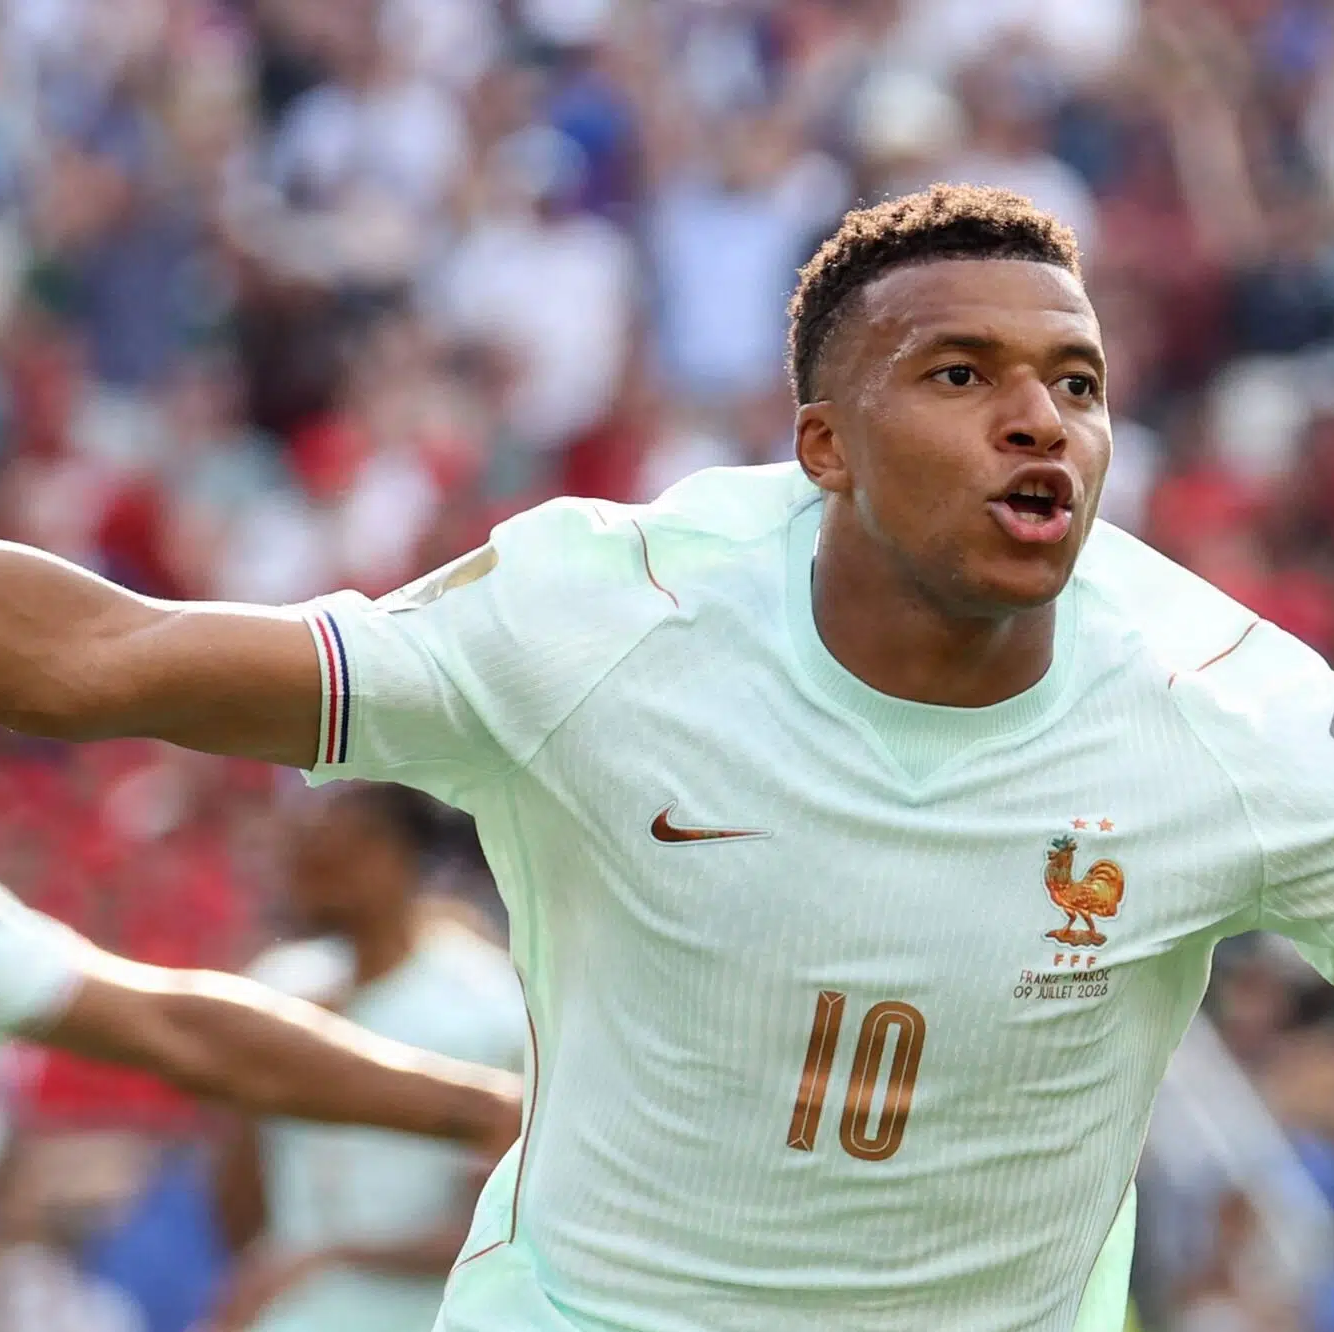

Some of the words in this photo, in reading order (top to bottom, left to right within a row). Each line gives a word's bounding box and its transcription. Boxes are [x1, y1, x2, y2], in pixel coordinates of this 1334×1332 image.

[1019, 969, 1060, 985] FRANCE
[1071, 968, 1112, 984] MAROC
[1013, 985, 1033, 999] 09
[1035, 985, 1073, 1000] JUILLET
[1077, 983, 1109, 999] 2026
[786, 990, 926, 1162] 10
